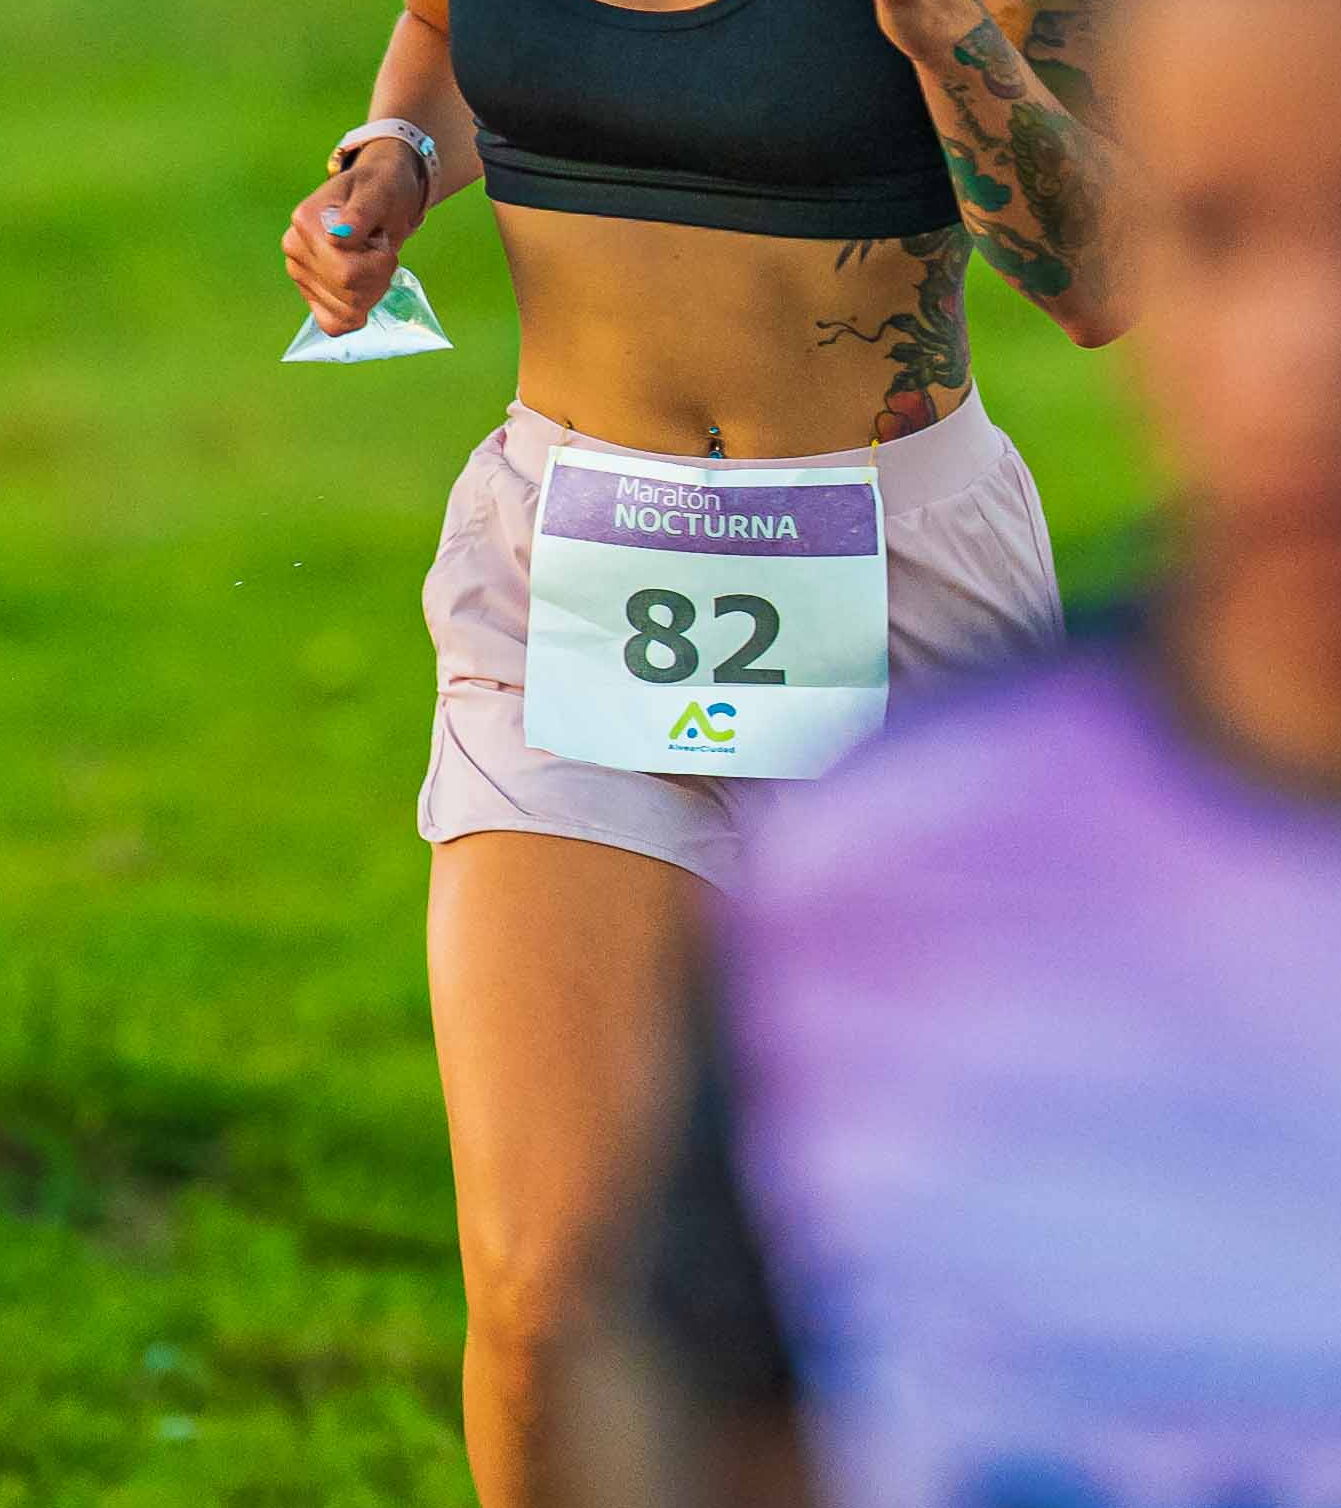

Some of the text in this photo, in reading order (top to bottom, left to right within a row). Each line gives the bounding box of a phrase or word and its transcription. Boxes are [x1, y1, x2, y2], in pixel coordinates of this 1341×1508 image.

[615, 477, 721, 511] Maratón
[614, 503, 800, 540] NOCTURNA
[623, 587, 787, 685] 82
